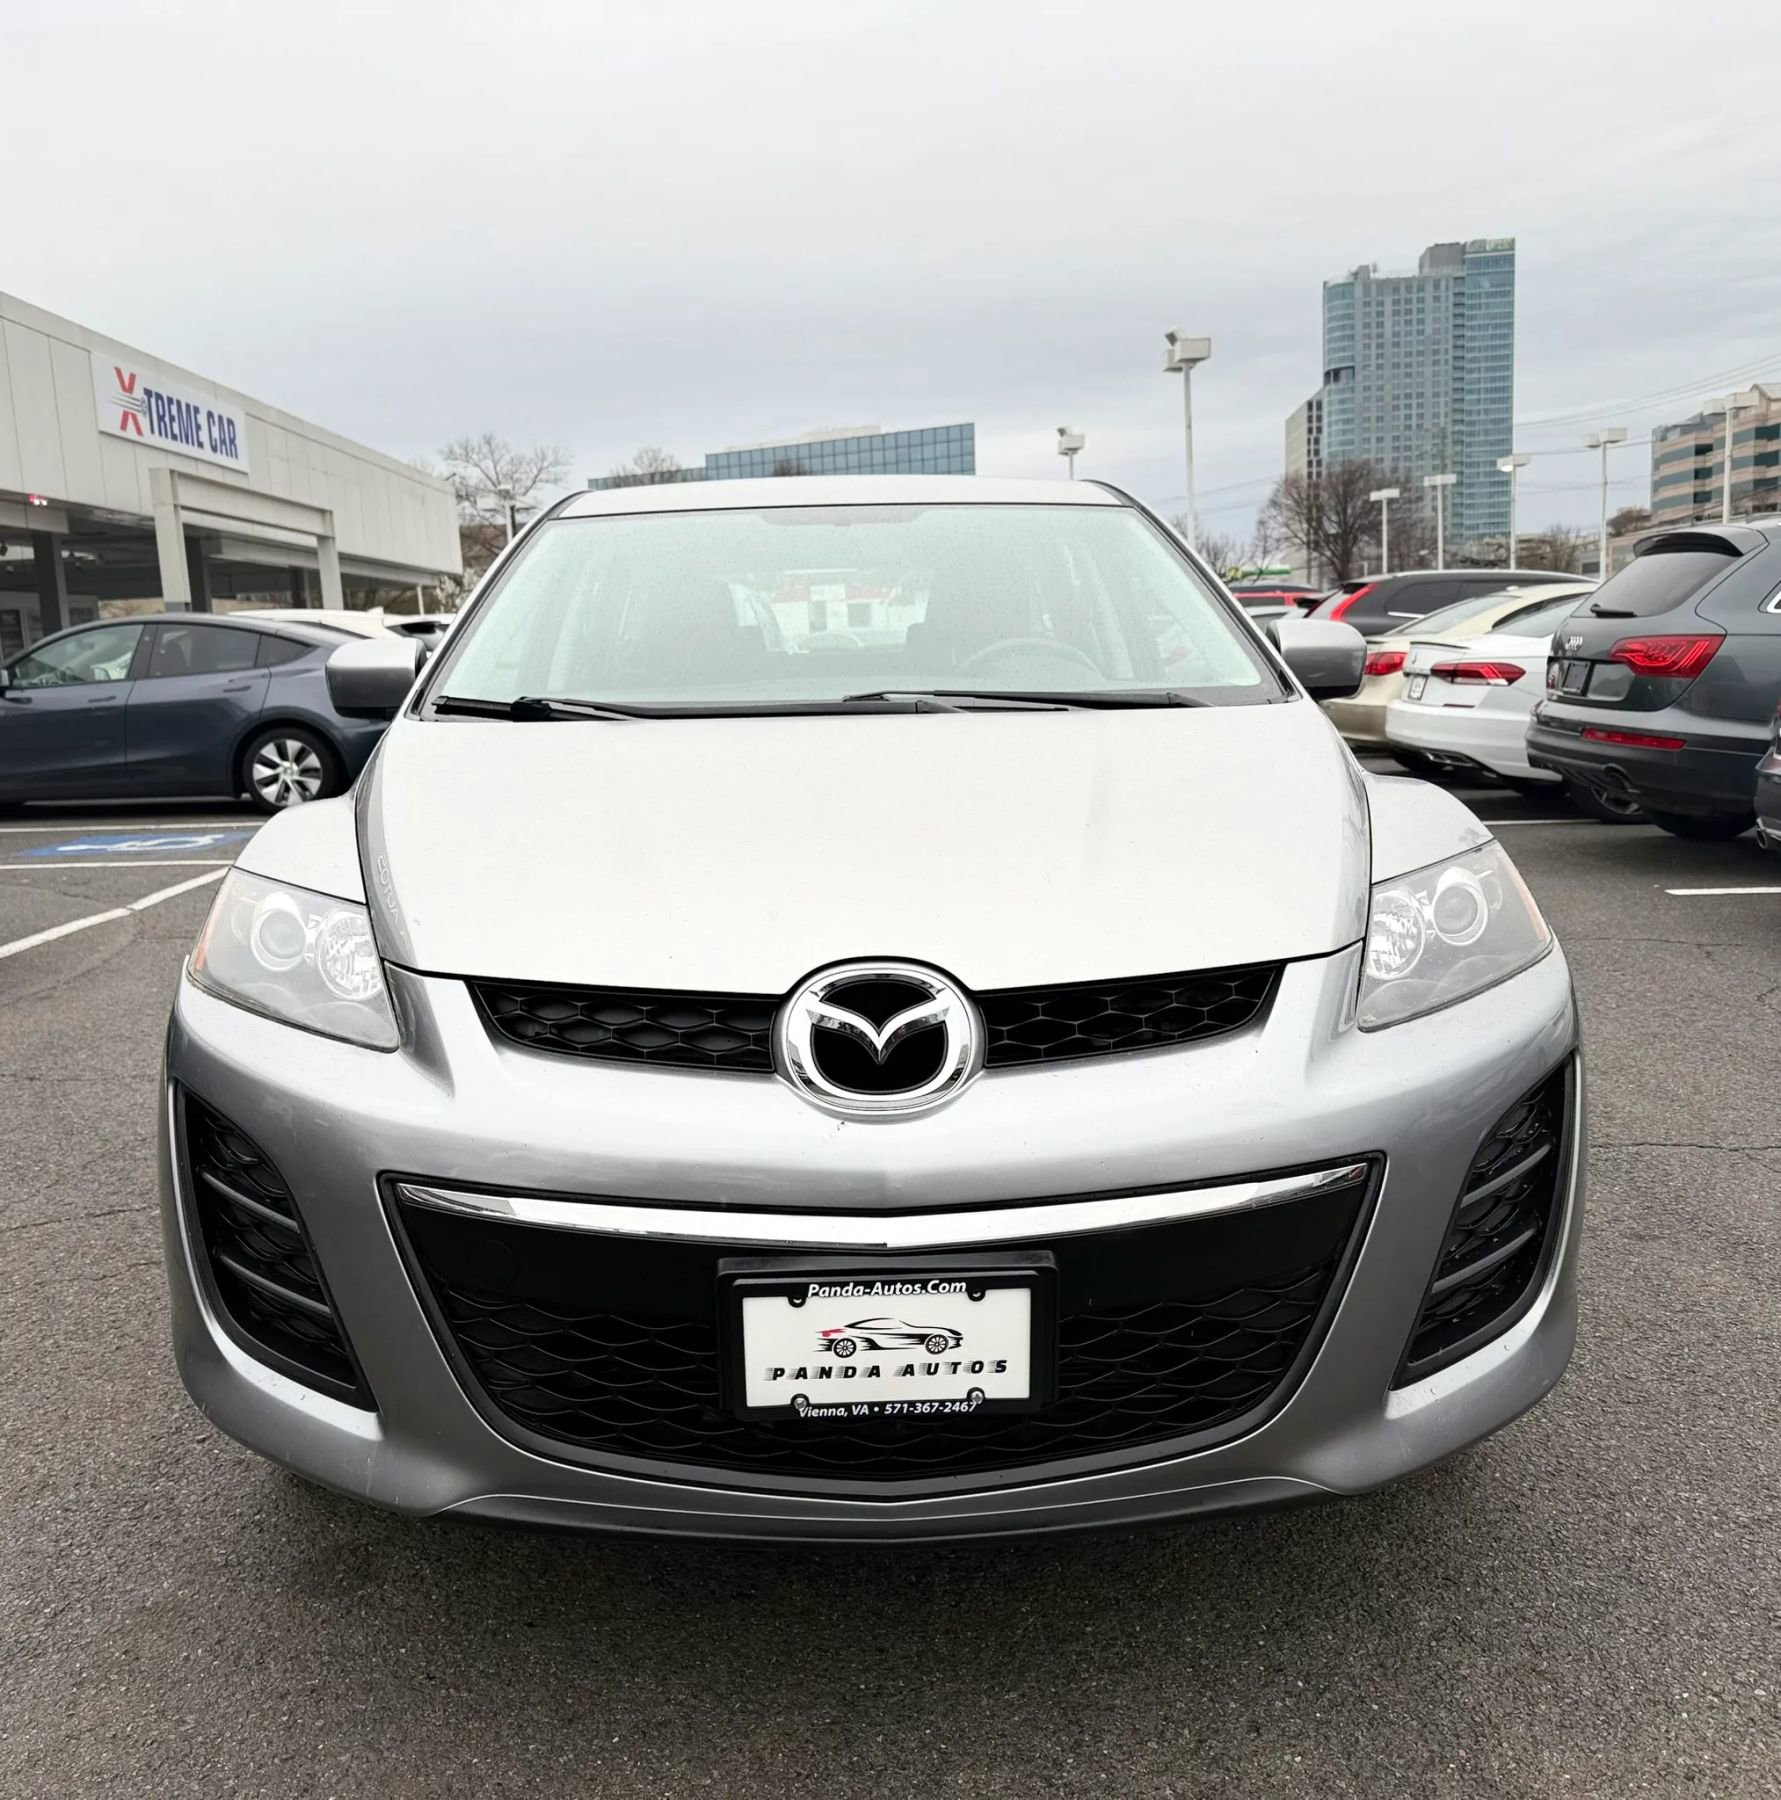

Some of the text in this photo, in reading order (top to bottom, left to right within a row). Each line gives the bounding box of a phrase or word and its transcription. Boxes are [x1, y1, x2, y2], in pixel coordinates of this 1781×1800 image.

[206, 410, 239, 460] CAR
[807, 1279, 967, 1299] Panda-Autos.Com
[767, 1360, 1007, 1381] PANDA AUTOS
[799, 1401, 977, 1418] Vienna, VA 571-367-2467
